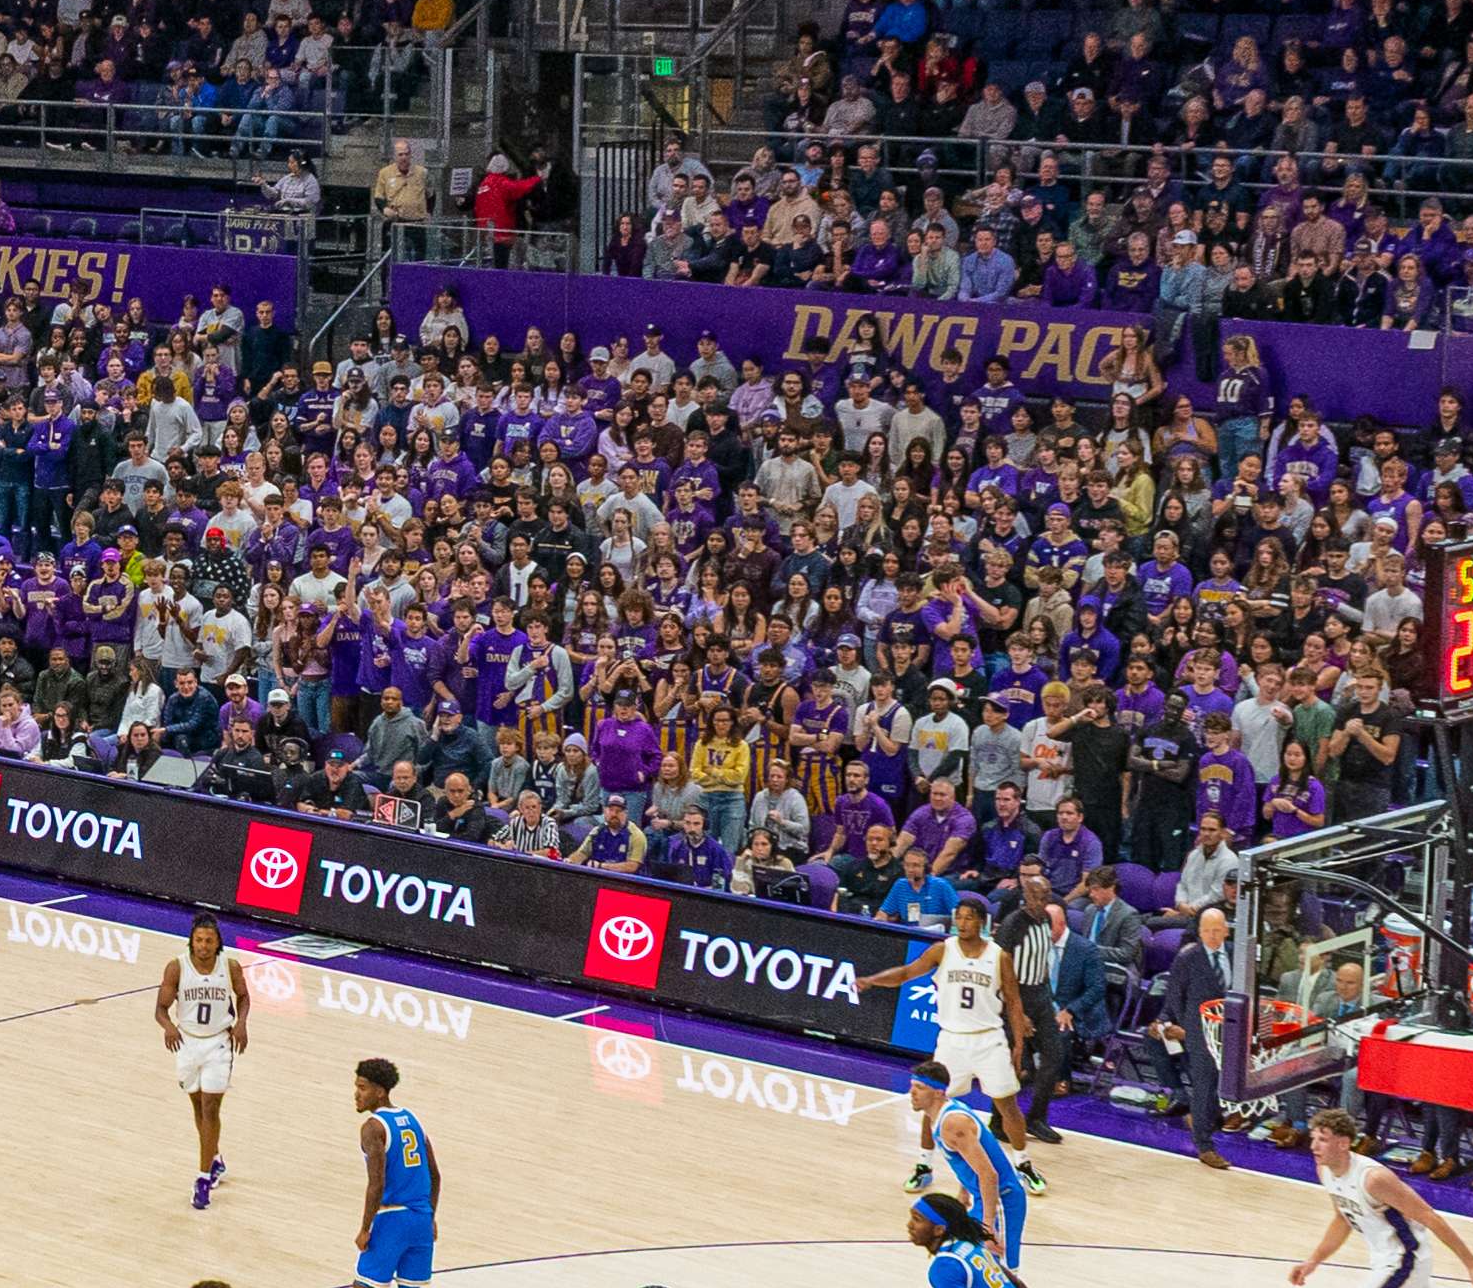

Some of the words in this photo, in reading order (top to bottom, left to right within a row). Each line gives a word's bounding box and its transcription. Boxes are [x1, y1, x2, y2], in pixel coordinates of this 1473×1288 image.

[1217, 378, 1243, 403] 10
[7, 798, 143, 859] TOYOTA
[320, 859, 476, 927] TOYOTA
[680, 929, 860, 1006] TOYOTA
[948, 971, 992, 987] HUSKIES
[184, 987, 226, 1001] HUSKIES
[960, 987, 974, 1009] 9
[197, 1003, 211, 1025] 0
[401, 1129, 421, 1169] 2
